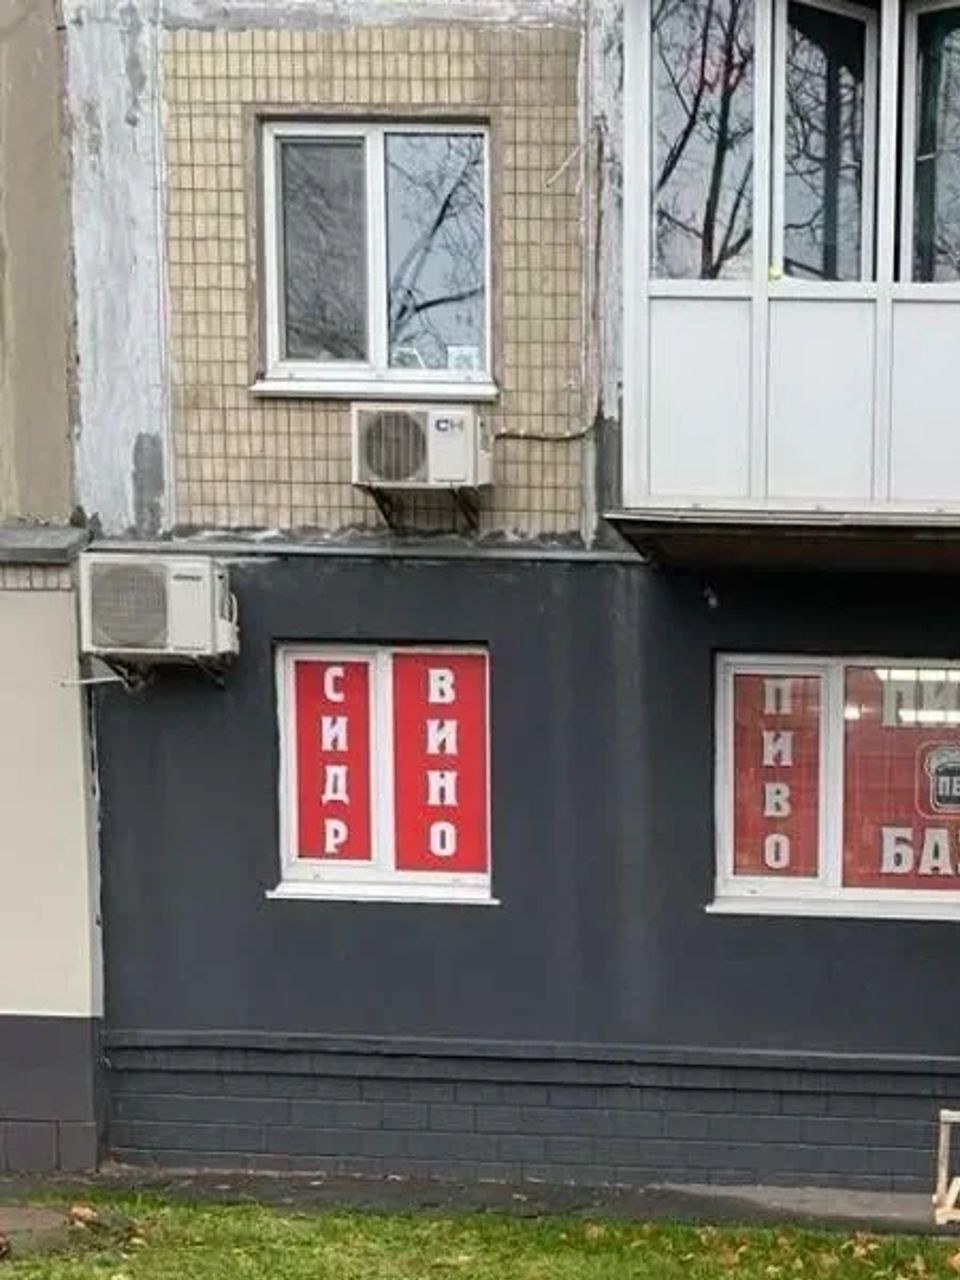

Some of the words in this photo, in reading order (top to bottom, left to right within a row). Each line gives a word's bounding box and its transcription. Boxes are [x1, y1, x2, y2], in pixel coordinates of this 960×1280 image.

[321, 666, 350, 855] СИДР
[426, 667, 459, 858] ВИНО
[762, 678, 794, 870] ПИВО
